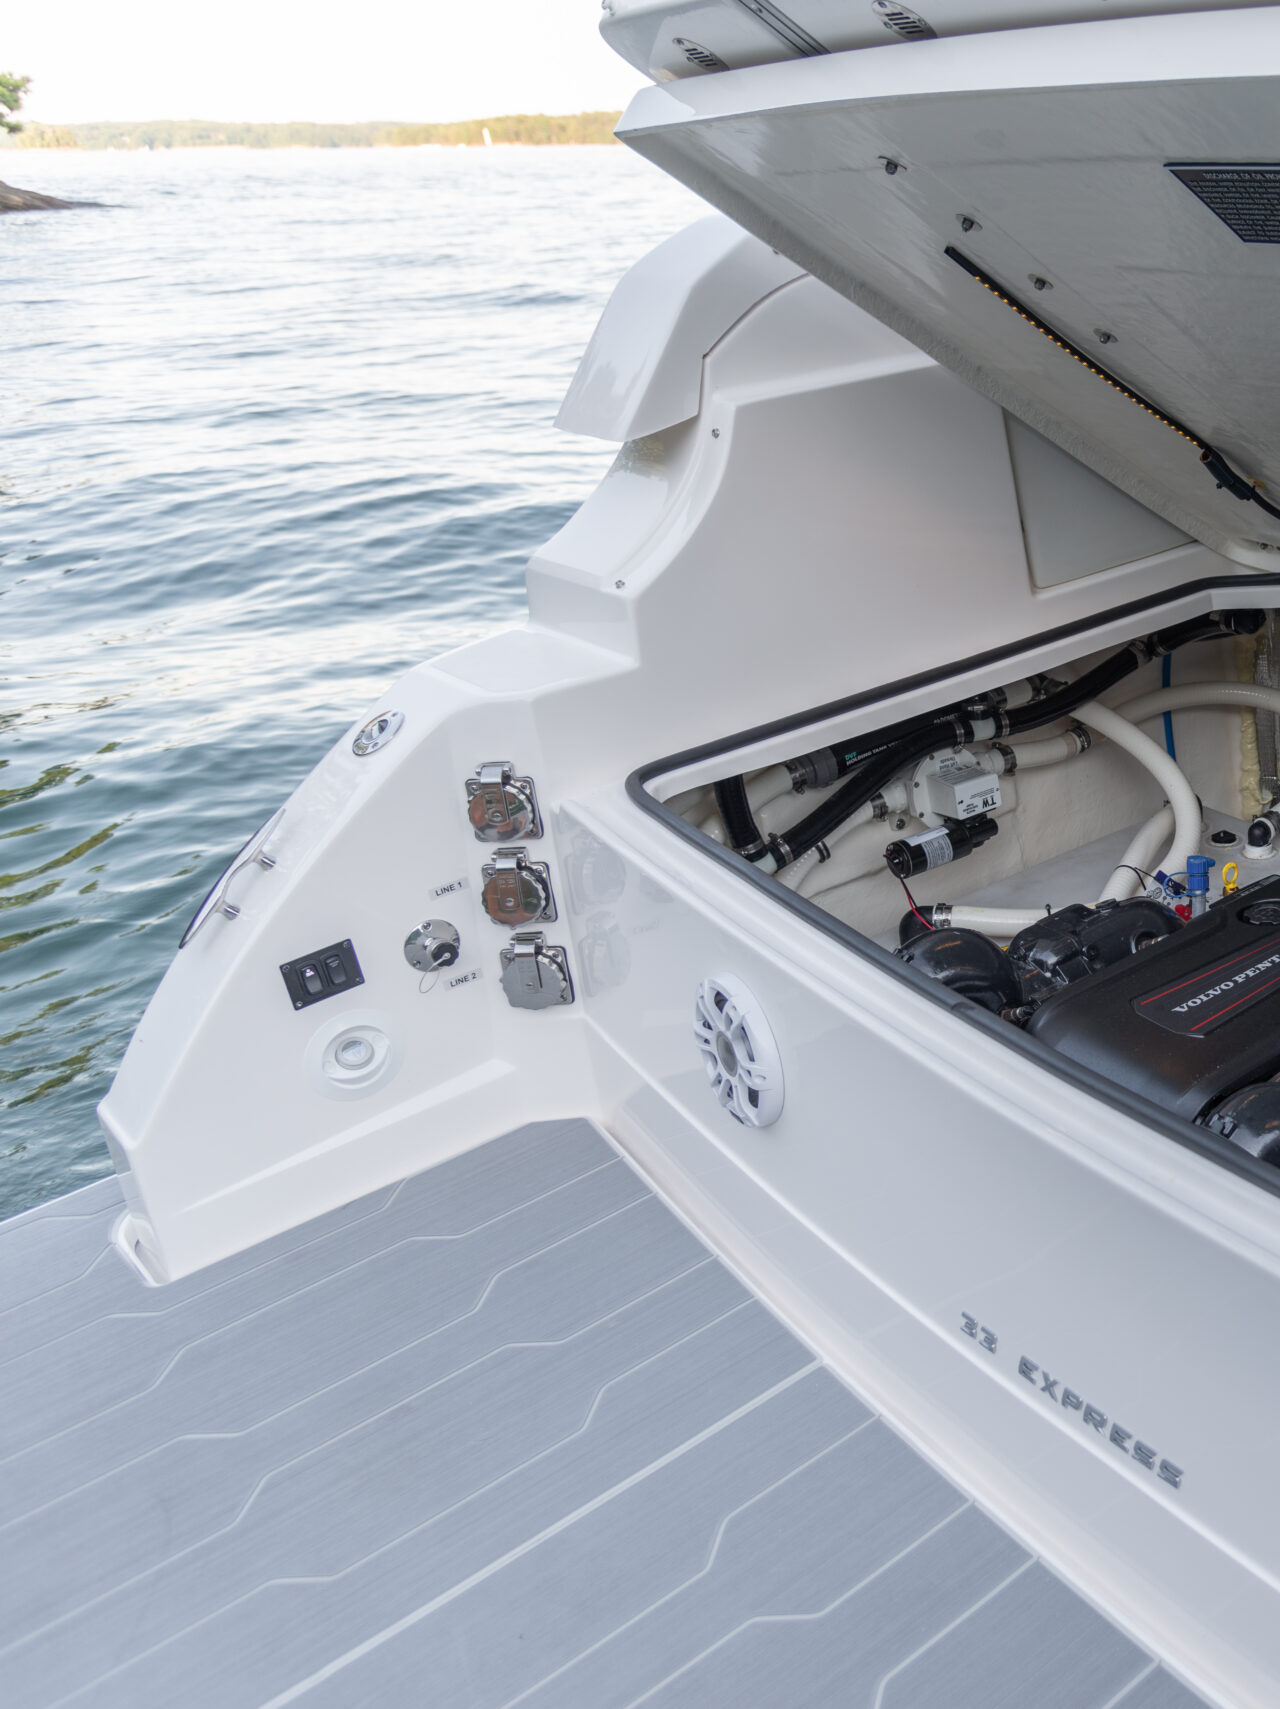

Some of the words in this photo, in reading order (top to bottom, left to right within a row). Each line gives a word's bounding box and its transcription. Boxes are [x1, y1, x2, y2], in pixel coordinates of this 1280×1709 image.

[982, 795, 997, 809] TW
[435, 883, 456, 897] LINE
[450, 975, 469, 988] LINE
[471, 972, 477, 980] 2
[1170, 981, 1235, 1013] VOLVO
[1017, 1354, 1185, 1490] EXPRESS
